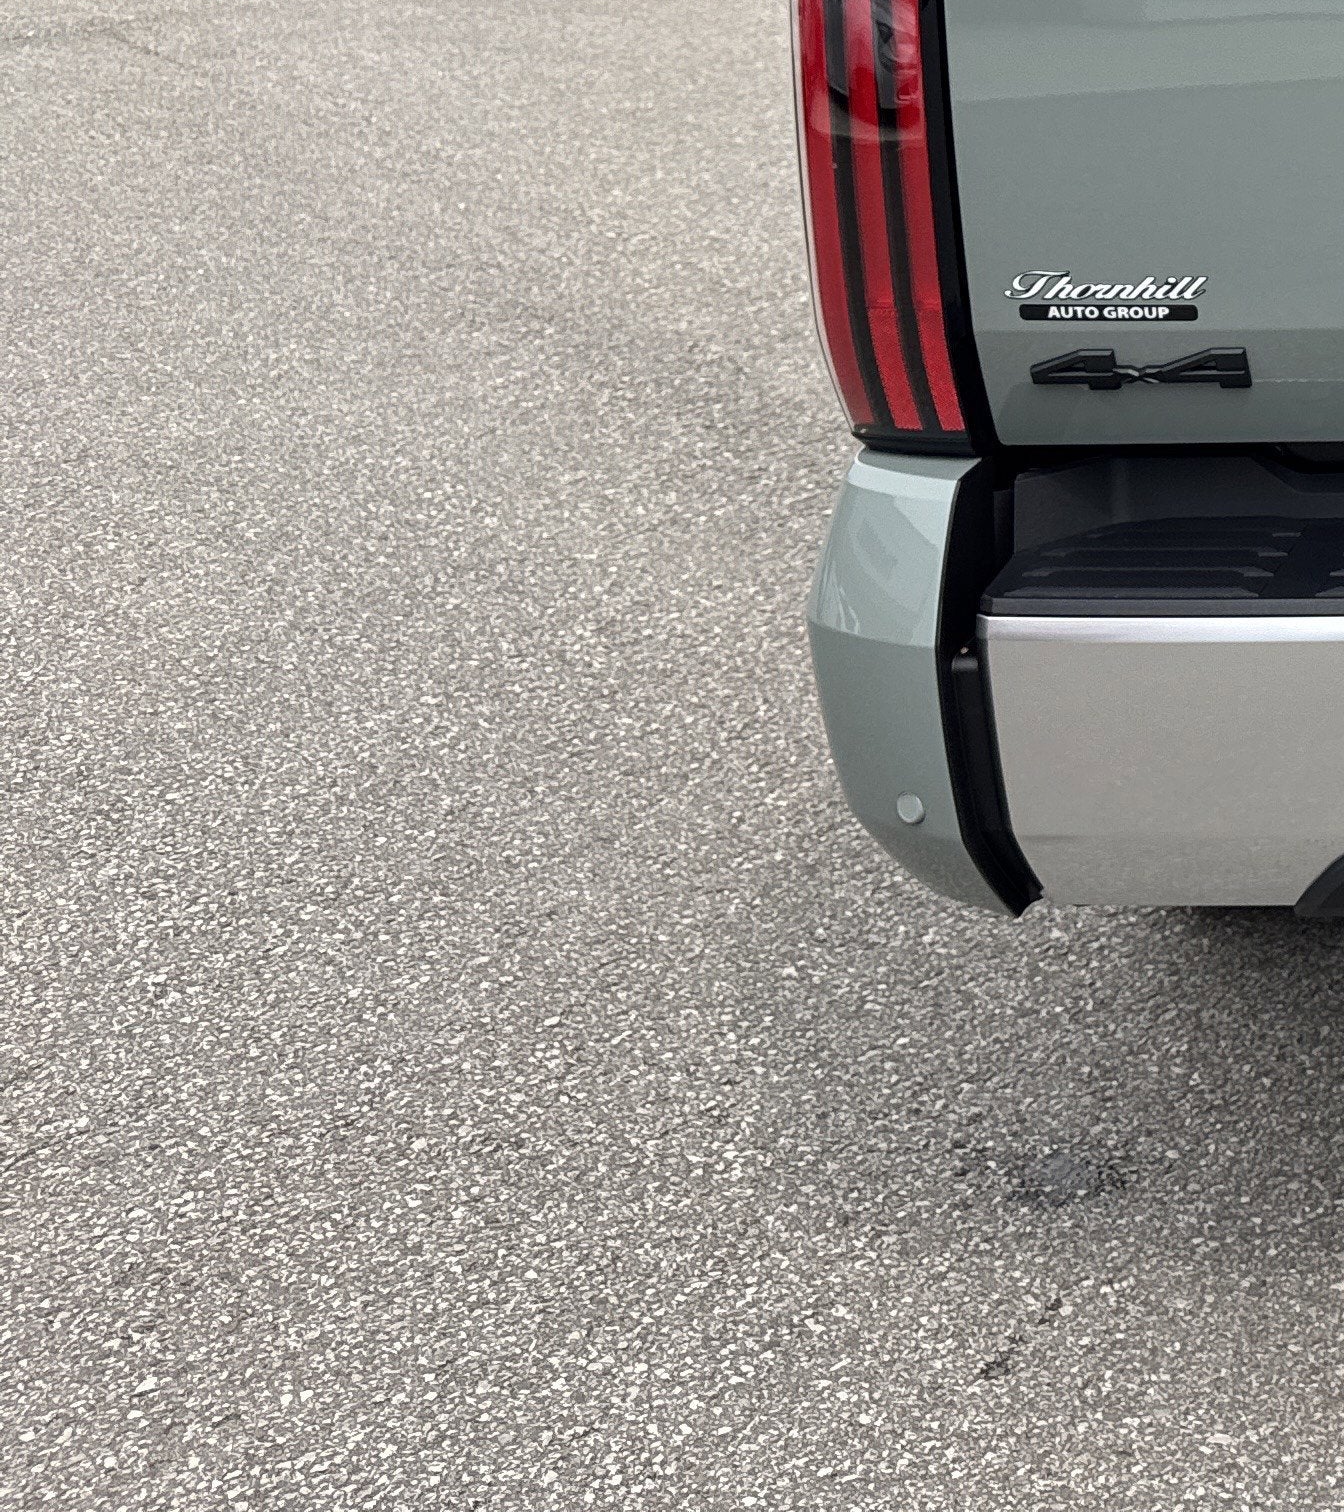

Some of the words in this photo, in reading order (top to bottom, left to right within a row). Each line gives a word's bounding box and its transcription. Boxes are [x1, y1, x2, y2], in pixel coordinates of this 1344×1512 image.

[1004, 270, 1209, 301] Thornhill
[1047, 306, 1100, 319] AUTO
[1102, 306, 1170, 319] GROUP
